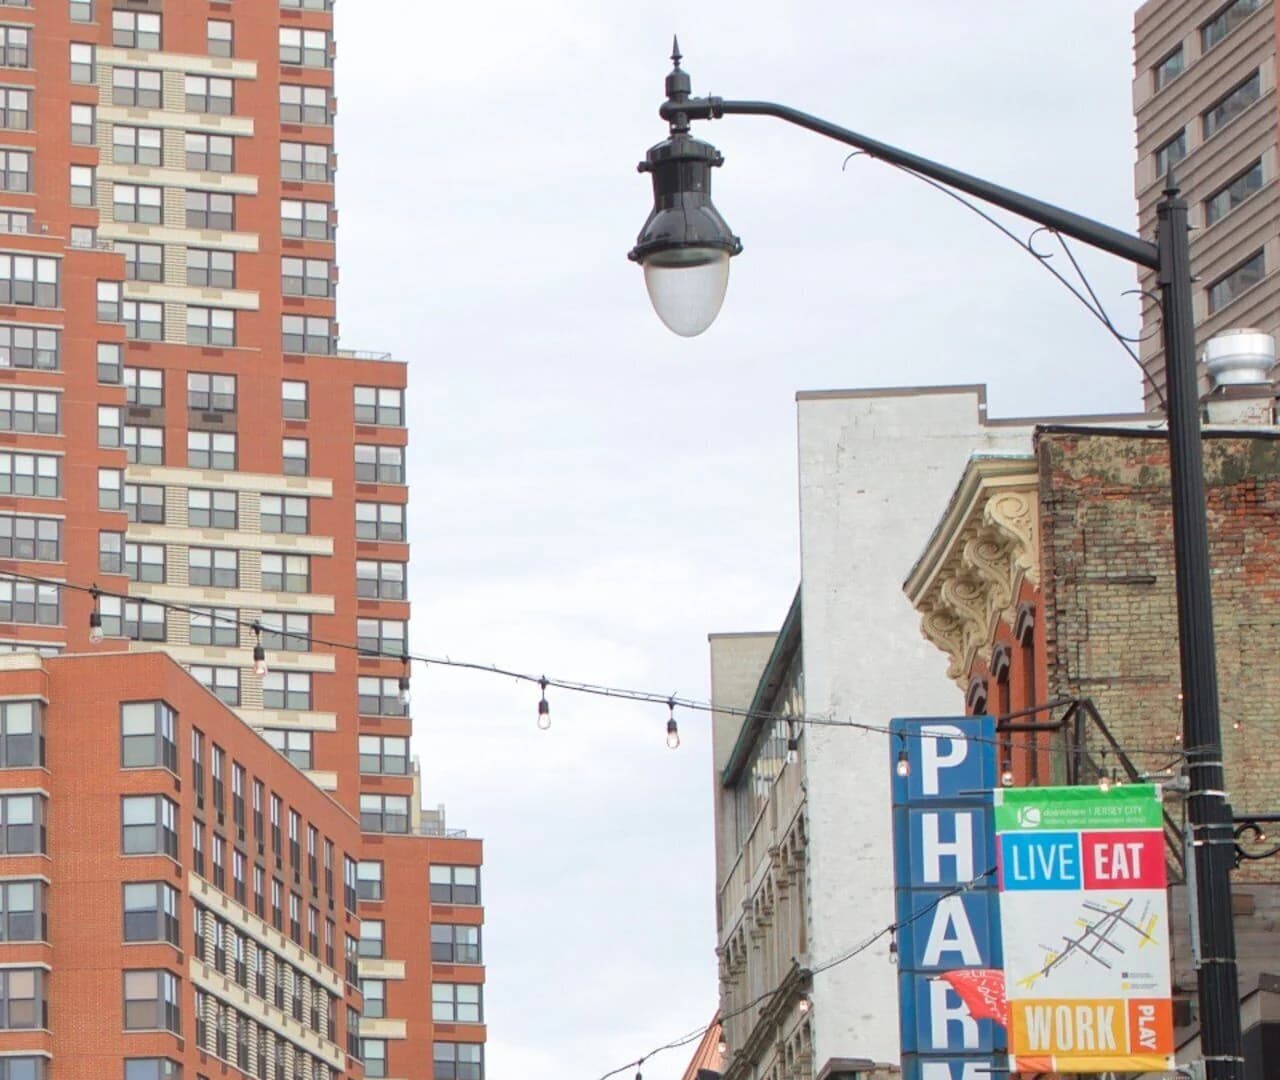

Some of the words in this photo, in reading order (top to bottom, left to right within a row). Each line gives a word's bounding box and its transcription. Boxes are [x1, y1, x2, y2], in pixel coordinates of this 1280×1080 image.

[1012, 844, 1075, 880] LIVE
[1093, 843, 1144, 880] EAT
[1024, 1005, 1117, 1050] WORK
[1138, 1005, 1157, 1049] PLAY
